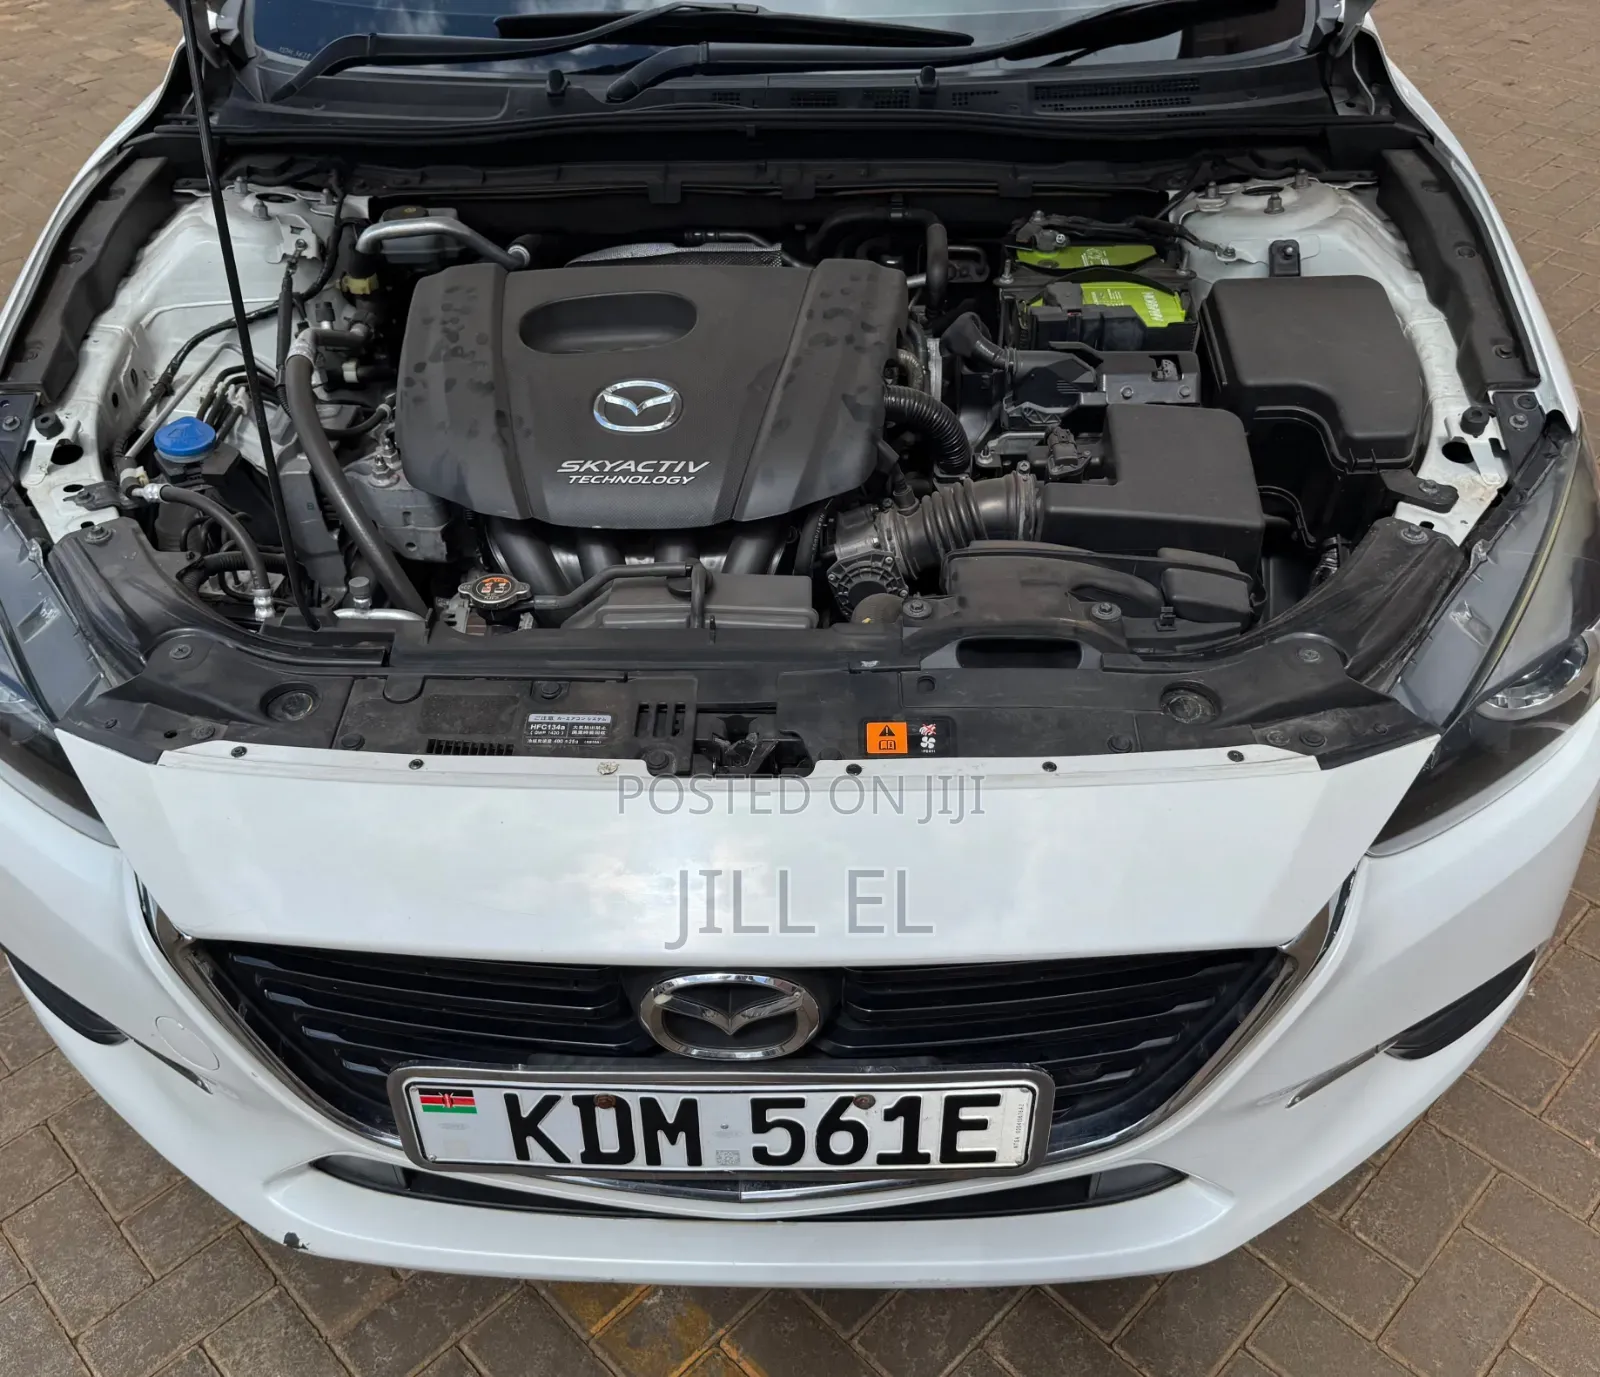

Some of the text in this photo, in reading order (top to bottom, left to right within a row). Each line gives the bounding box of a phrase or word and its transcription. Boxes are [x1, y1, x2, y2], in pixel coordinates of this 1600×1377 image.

[557, 460, 710, 473] SKYACTIV
[569, 475, 695, 485] TECHNOLOGY
[503, 1092, 1002, 1167] KDM 561E
